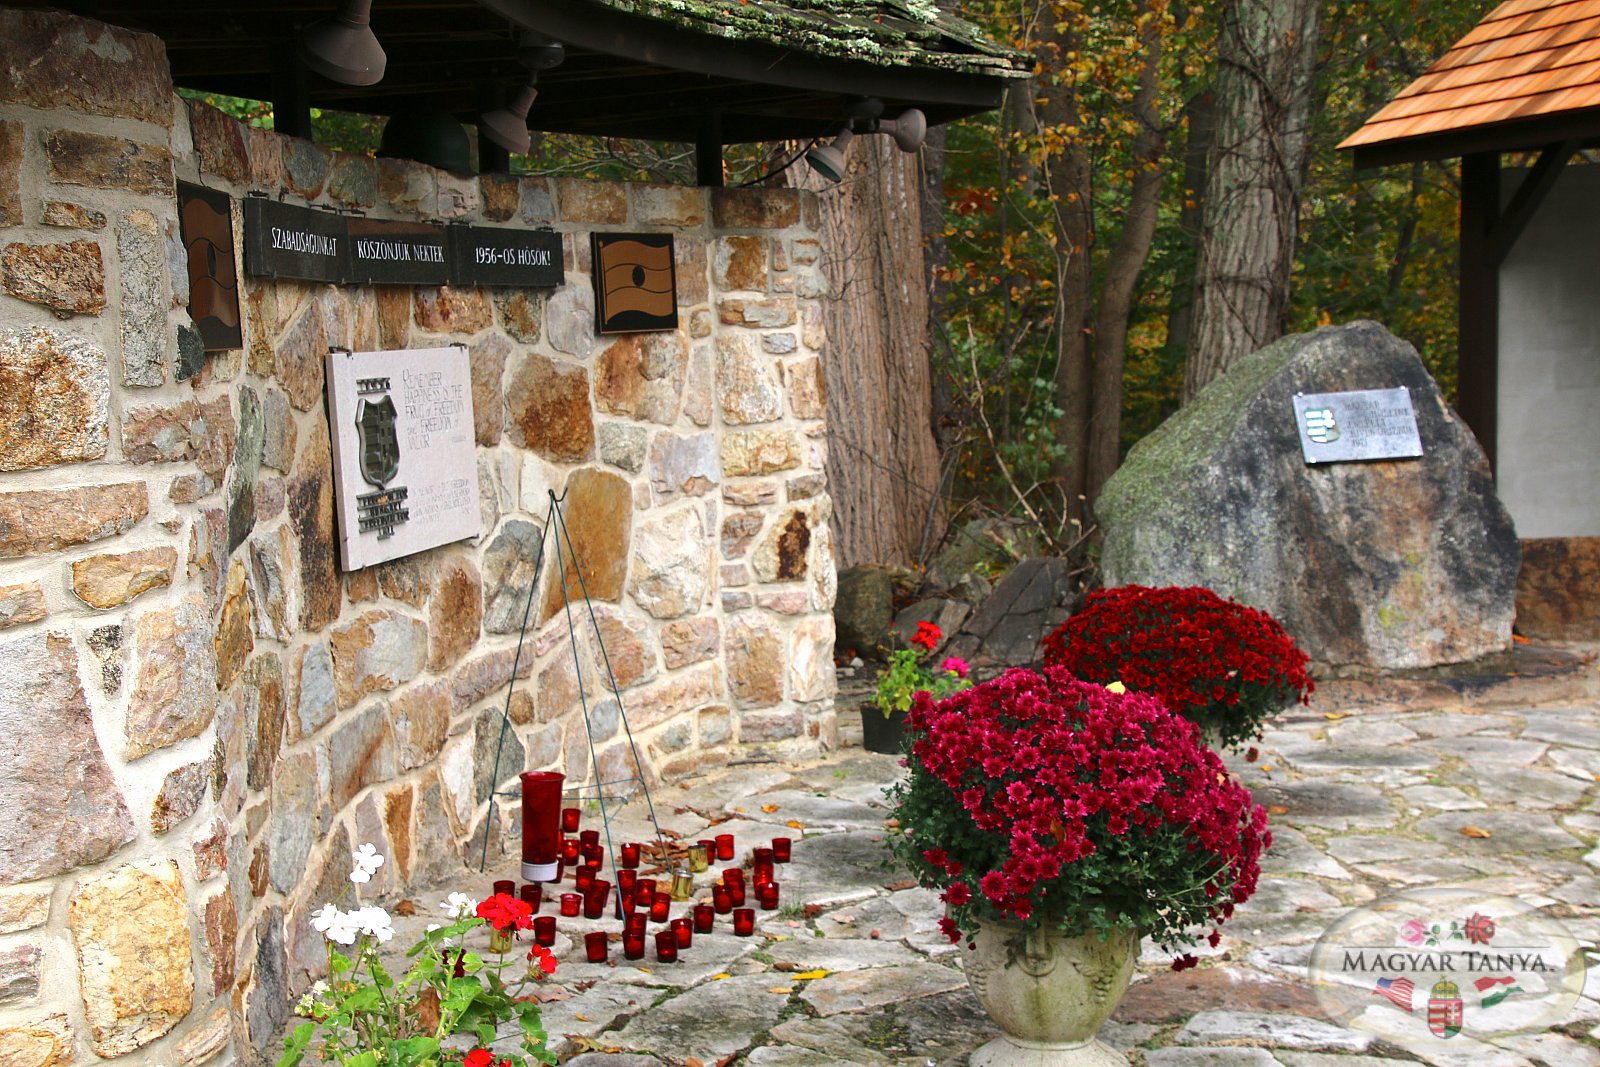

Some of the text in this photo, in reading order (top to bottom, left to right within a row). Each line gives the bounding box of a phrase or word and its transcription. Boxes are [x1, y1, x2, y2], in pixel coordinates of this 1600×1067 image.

[271, 227, 337, 257] SZABADSÁGUNKAT
[357, 238, 444, 263] KÖSZÖNJÜK NEKTEK
[475, 247, 516, 265] 1956-OS
